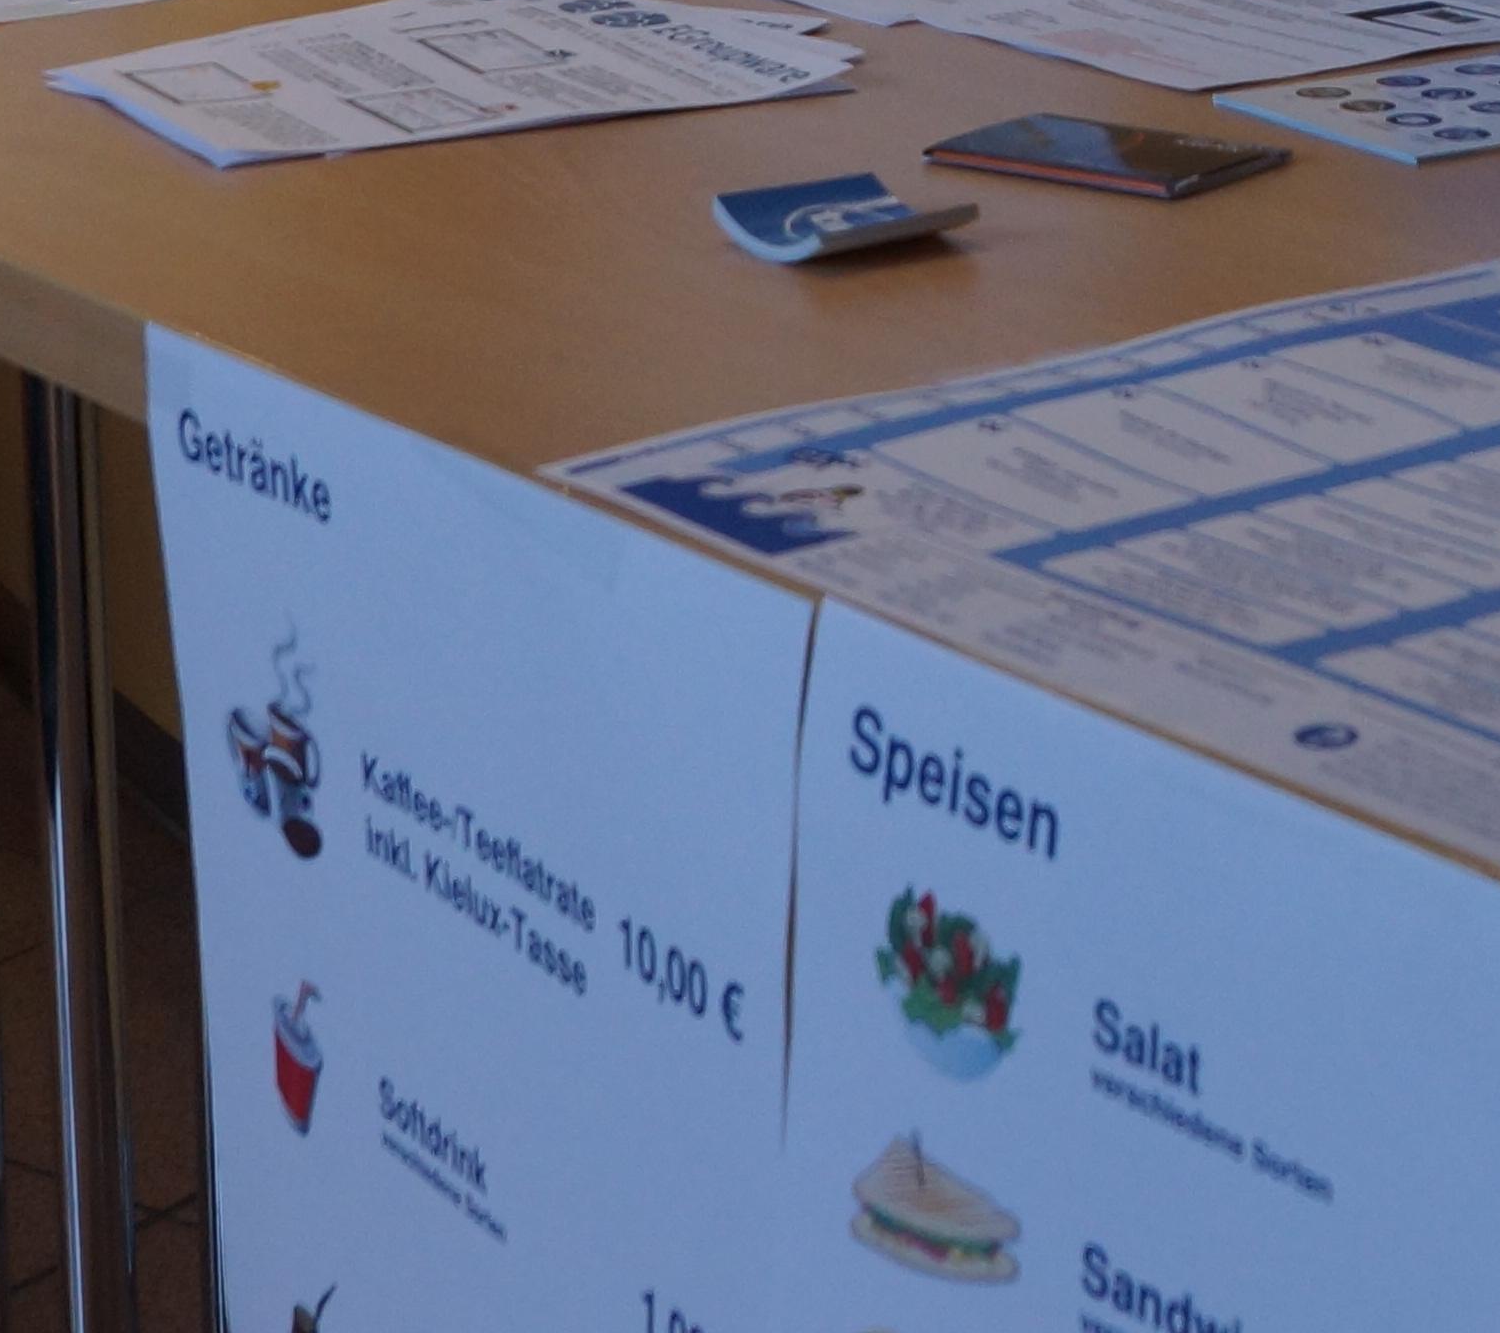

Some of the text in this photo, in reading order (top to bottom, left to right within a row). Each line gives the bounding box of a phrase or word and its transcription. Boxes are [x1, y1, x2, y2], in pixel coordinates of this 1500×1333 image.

[177, 407, 332, 525] Getränke
[848, 706, 1061, 864] Speisen
[617, 914, 708, 1025] 10,00
[1091, 997, 1203, 1098] Salat
